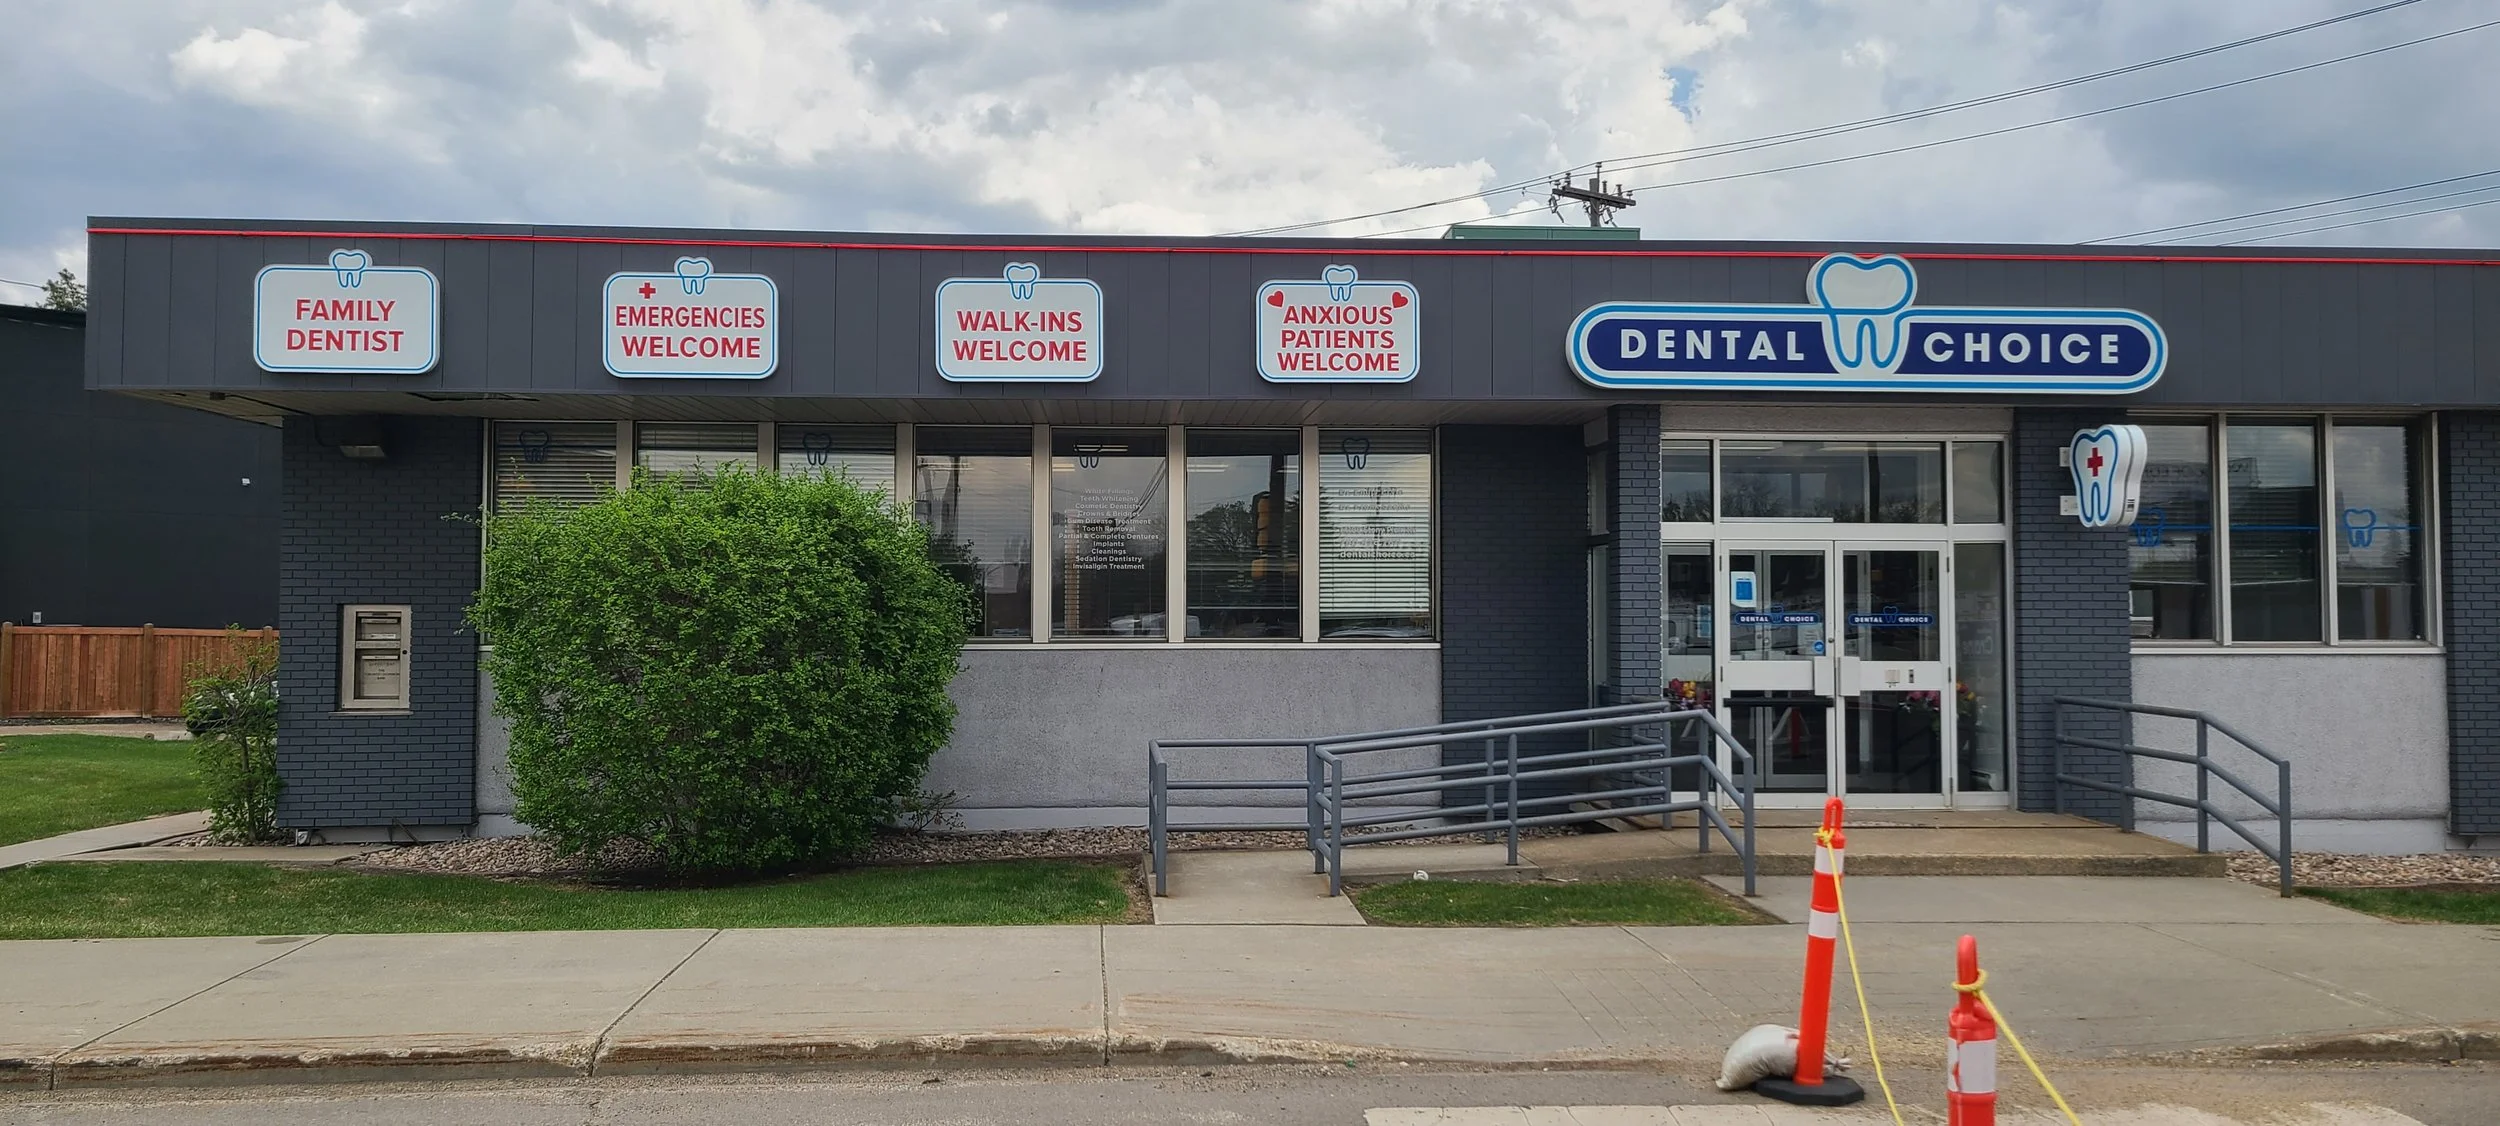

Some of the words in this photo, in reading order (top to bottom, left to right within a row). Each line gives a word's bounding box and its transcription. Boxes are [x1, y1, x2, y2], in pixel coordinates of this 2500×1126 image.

[296, 299, 396, 321] FAMILY
[616, 305, 765, 328] EMERGENCIES
[956, 310, 1083, 332] WALK-INS
[1283, 305, 1393, 325] ANXIOUS
[287, 329, 404, 352] DENTIST
[621, 335, 761, 358] WELCOME
[1281, 329, 1395, 349] PATIENTS
[1620, 329, 1805, 361] DENTAL
[1923, 331, 2120, 365] CHOICE
[953, 340, 1087, 362] WELCOME
[1277, 352, 1400, 372] WELCOME
[1102, 495, 1139, 503] Whitening
